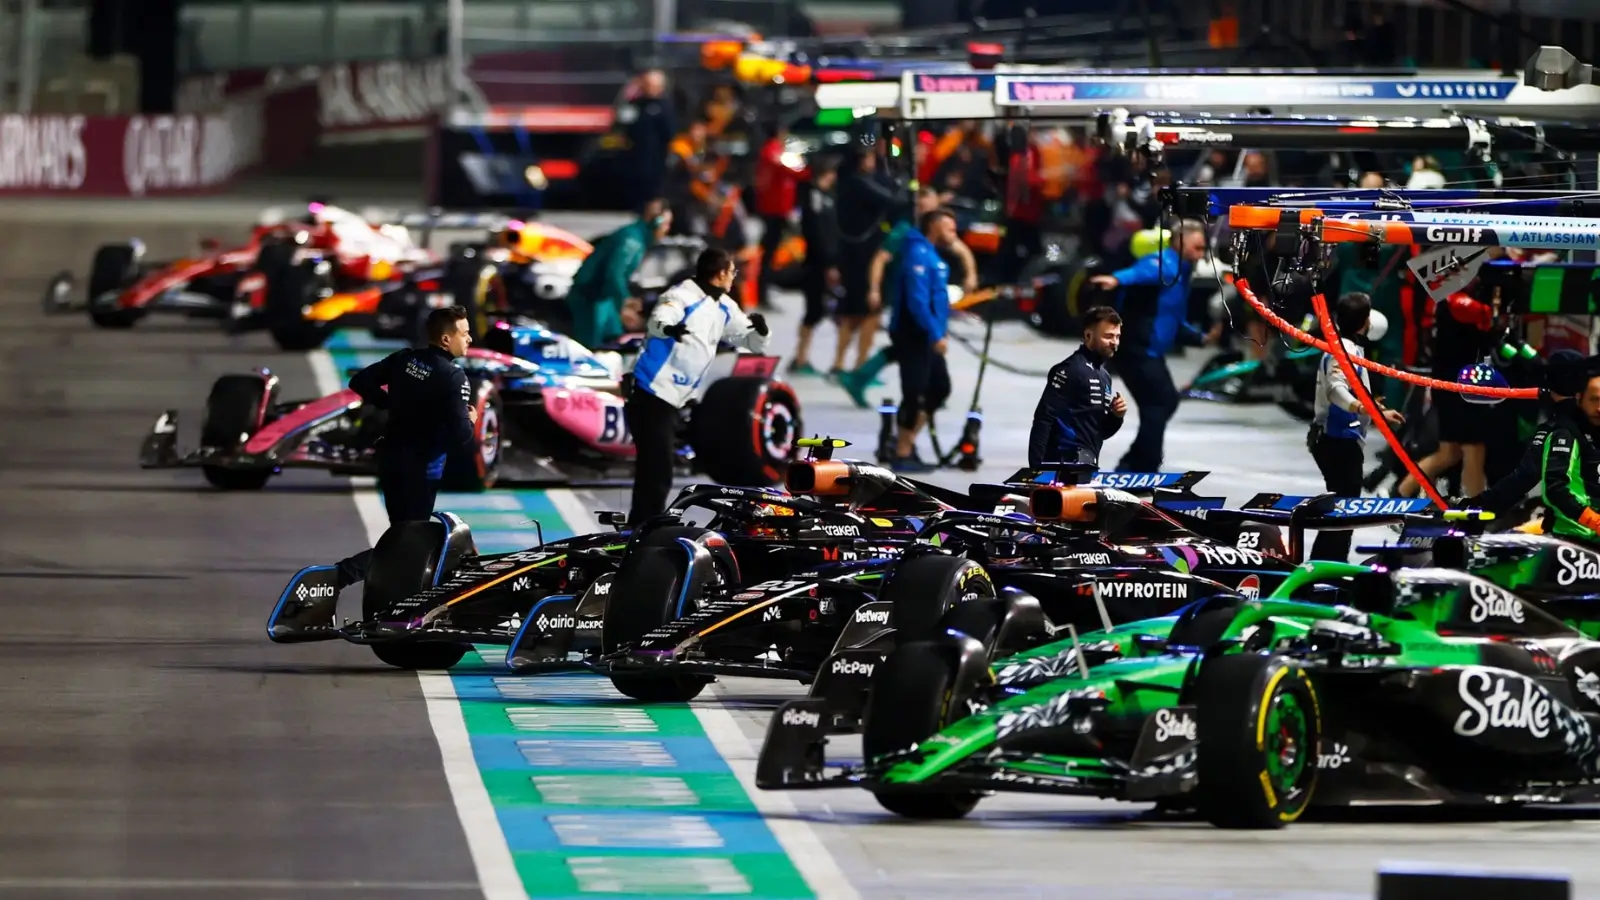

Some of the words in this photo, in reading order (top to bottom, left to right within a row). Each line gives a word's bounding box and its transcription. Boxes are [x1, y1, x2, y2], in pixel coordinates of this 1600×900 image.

[1426, 229, 1482, 243] Gulf
[1521, 232, 1596, 245] ATLASSIAN
[1237, 531, 1261, 548] 23
[309, 583, 334, 597] airia
[1098, 582, 1187, 599] MYPROTEIN
[1470, 579, 1525, 624] Stake
[549, 613, 575, 629] airia
[855, 609, 890, 625] betway
[832, 659, 875, 677] PicPay
[1453, 667, 1551, 739] Stake
[782, 708, 821, 728] PicPay
